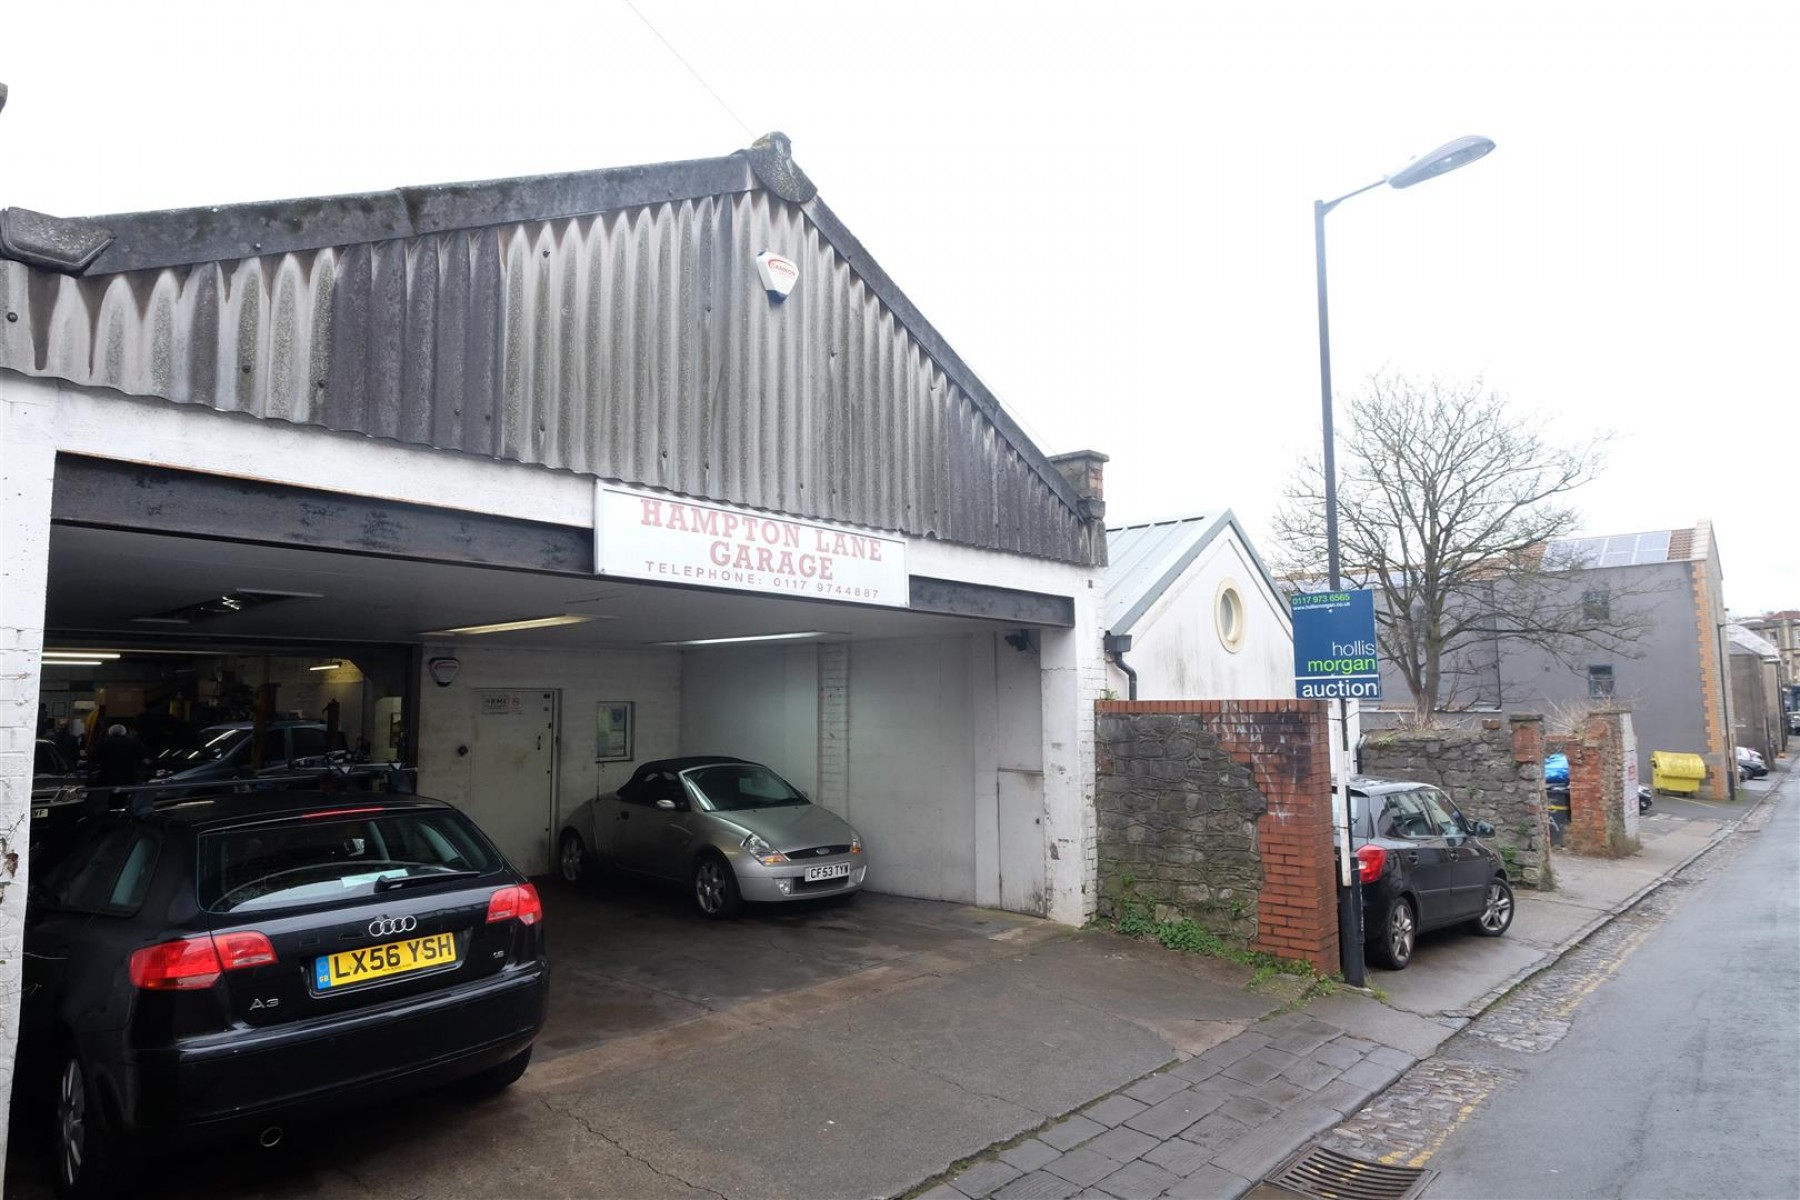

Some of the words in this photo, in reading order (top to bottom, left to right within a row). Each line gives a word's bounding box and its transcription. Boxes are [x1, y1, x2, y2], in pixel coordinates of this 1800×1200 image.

[640, 498, 800, 548] HAMPTON
[815, 529, 882, 562] LANE
[709, 540, 833, 581] GARAGE
[645, 560, 762, 585] TELEPHONE:
[773, 577, 807, 591] 0117
[817, 581, 879, 599] 9744887
[1332, 640, 1376, 657] hollis
[1307, 658, 1376, 675] morgan
[1302, 680, 1377, 697] auction
[810, 867, 833, 878] CF53
[333, 943, 401, 979] LX56
[407, 934, 453, 961] YSH
[249, 997, 279, 1011] A3
